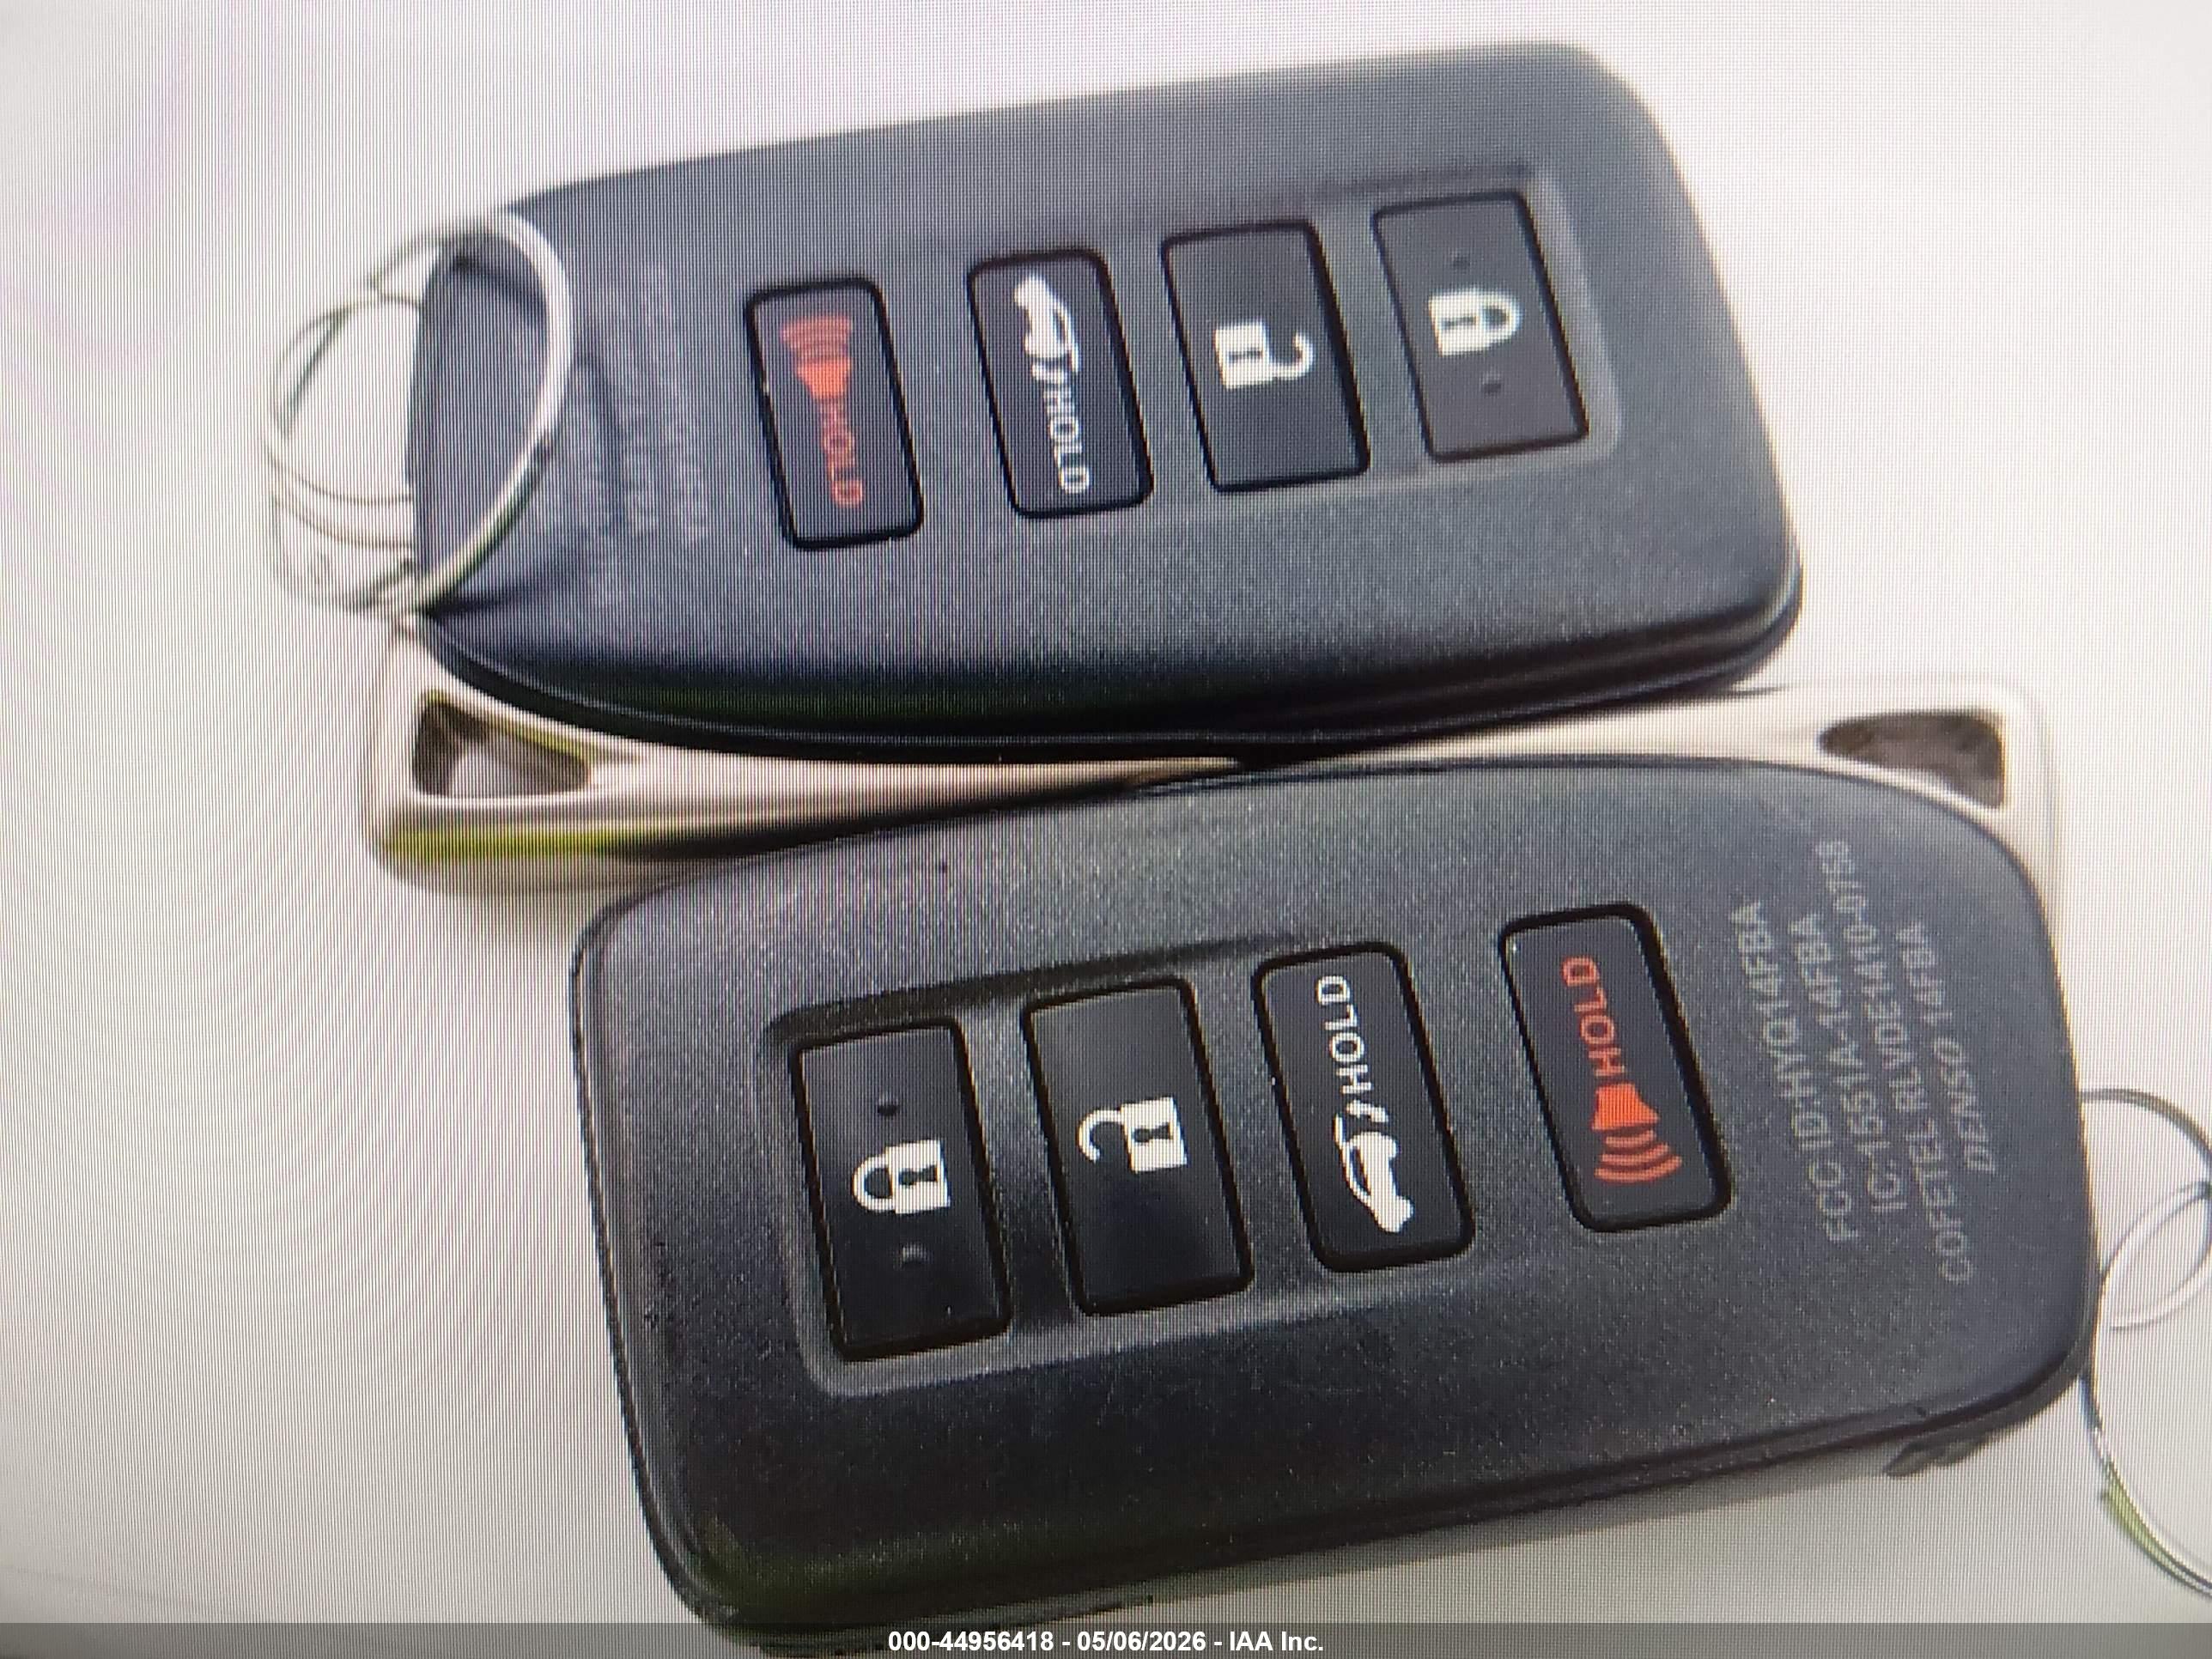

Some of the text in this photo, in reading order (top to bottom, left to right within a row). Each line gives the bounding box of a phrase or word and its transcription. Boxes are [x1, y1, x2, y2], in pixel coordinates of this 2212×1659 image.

[820, 398, 865, 507] HOLD
[1042, 385, 1092, 495] HOLD
[1316, 975, 1373, 1095] HOLD
[1561, 956, 1626, 1078] HOLD
[1729, 901, 1860, 1243] FCC ID:HYQ14FBA
[1788, 912, 1907, 1212] IC:1551A-14FBA
[1895, 921, 1996, 1174] DENSO 14FBA
[1905, 1118, 1973, 1283] COFETEL
